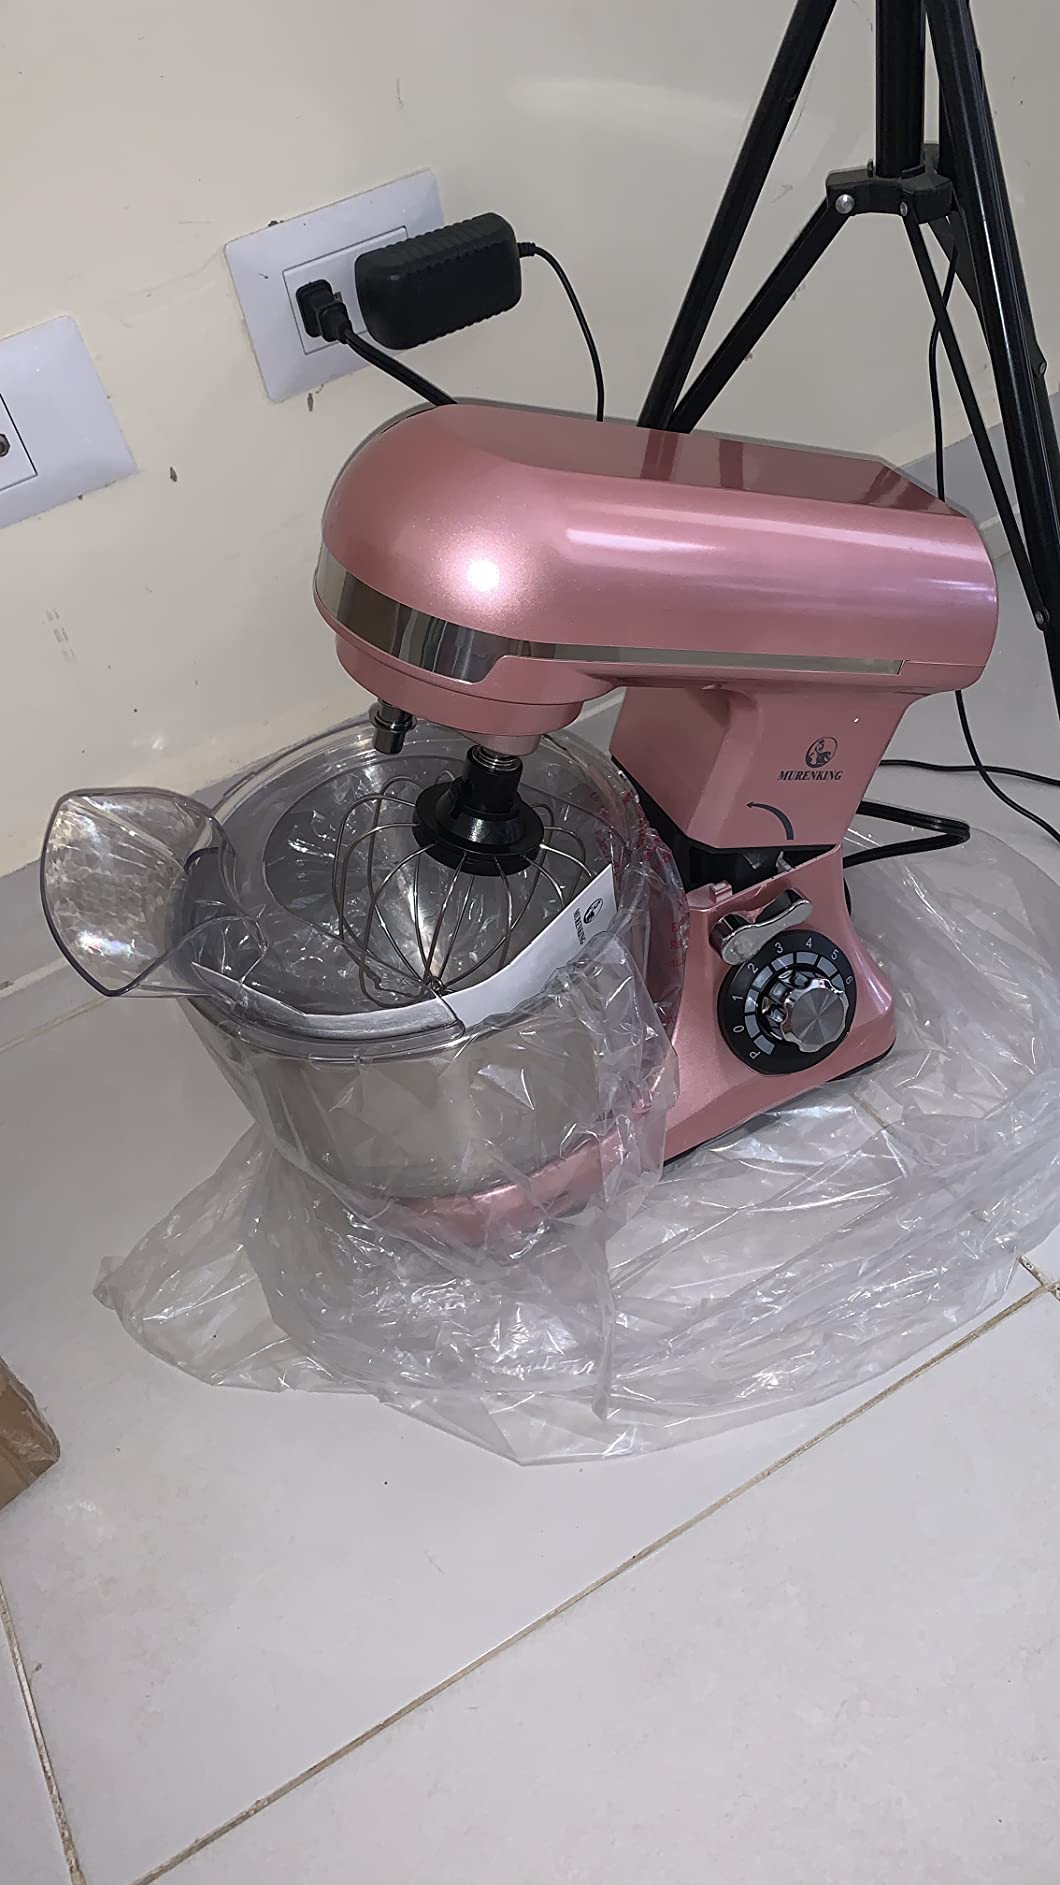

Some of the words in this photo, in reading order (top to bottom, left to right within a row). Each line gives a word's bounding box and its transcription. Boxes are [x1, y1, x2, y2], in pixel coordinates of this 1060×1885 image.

[777, 770, 843, 781] MURENKING
[774, 942, 784, 954] 3
[805, 937, 813, 949] 4
[831, 949, 839, 960] 5
[747, 962, 759, 974] 2
[749, 1051, 761, 1060] P
